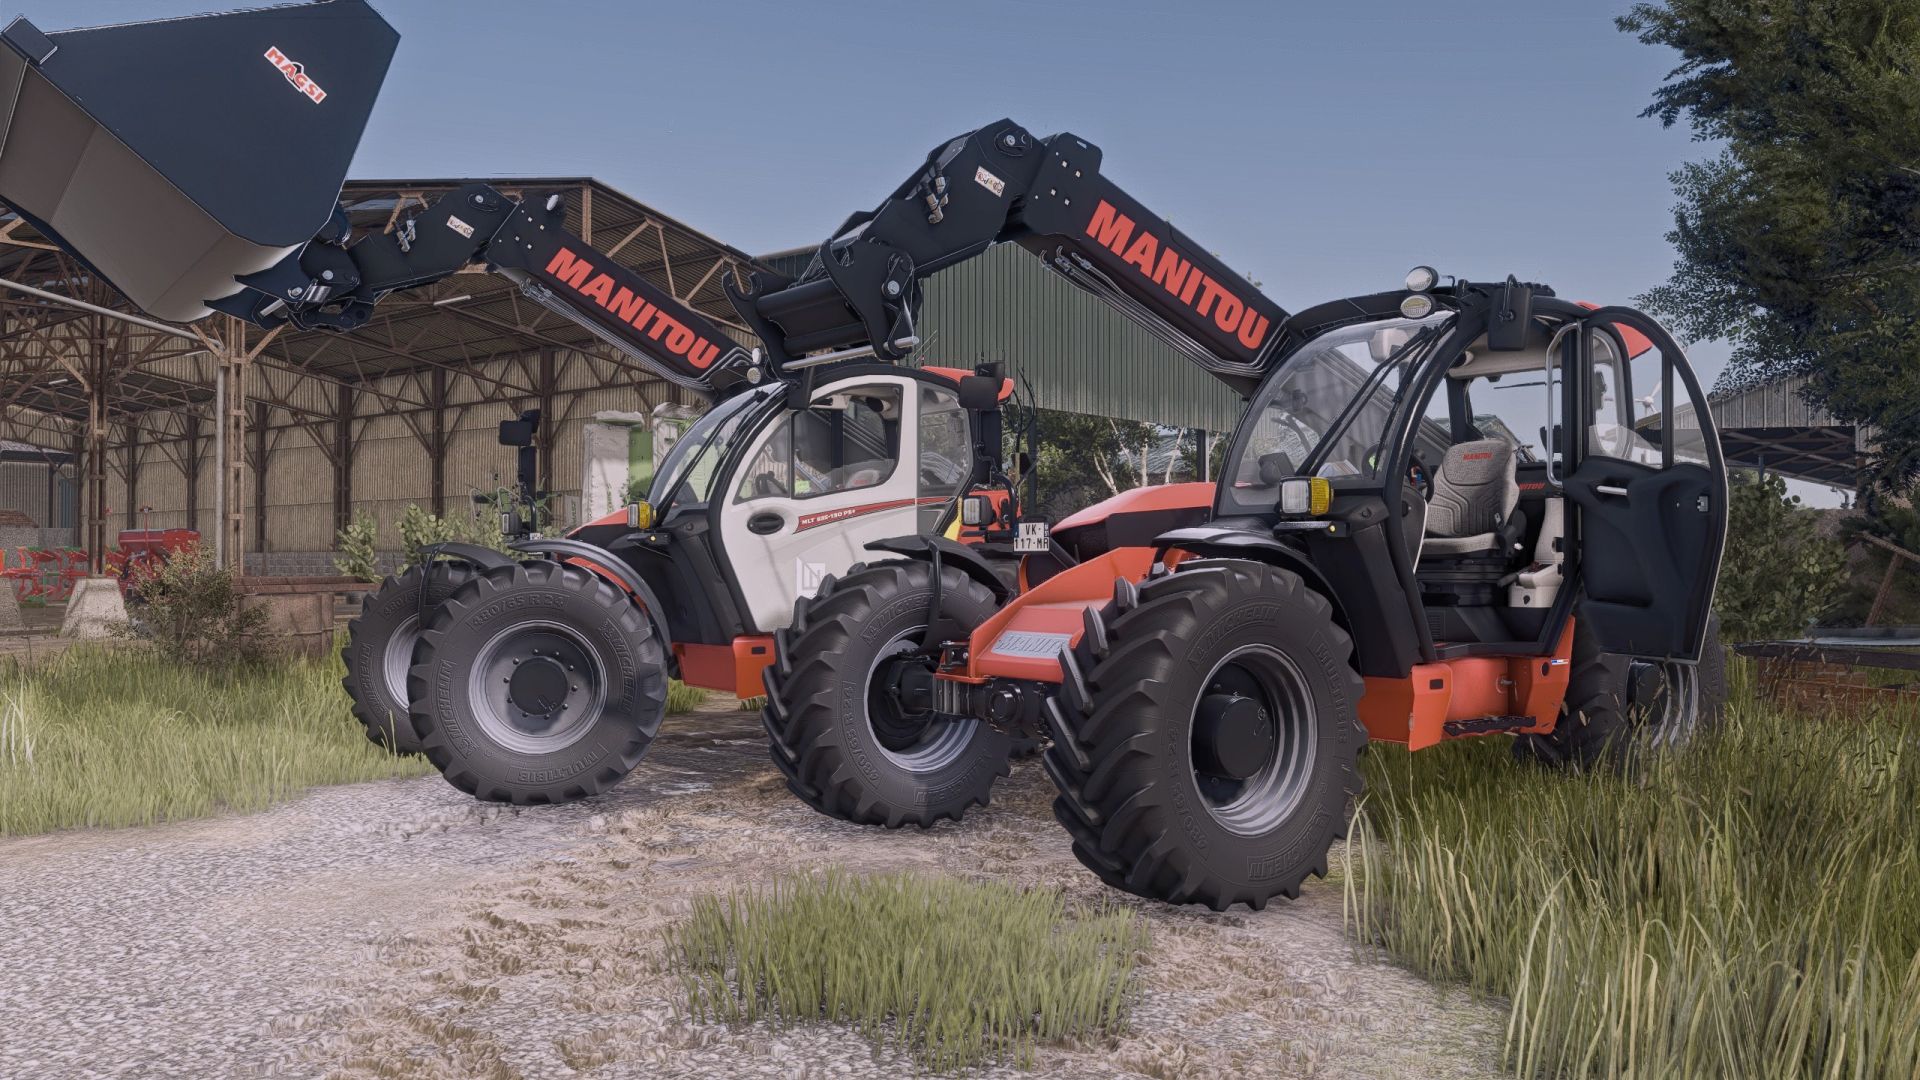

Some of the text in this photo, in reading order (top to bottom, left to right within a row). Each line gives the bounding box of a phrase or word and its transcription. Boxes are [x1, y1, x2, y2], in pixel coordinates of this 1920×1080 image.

[265, 47, 325, 103] MAGSI
[1085, 199, 1270, 350] MANITOU
[545, 247, 721, 369] MANITOU
[1519, 482, 1545, 491] NITOU
[801, 517, 815, 525] MLT
[1206, 605, 1281, 649] MICHELIN
[438, 660, 466, 744] MICHELIN
